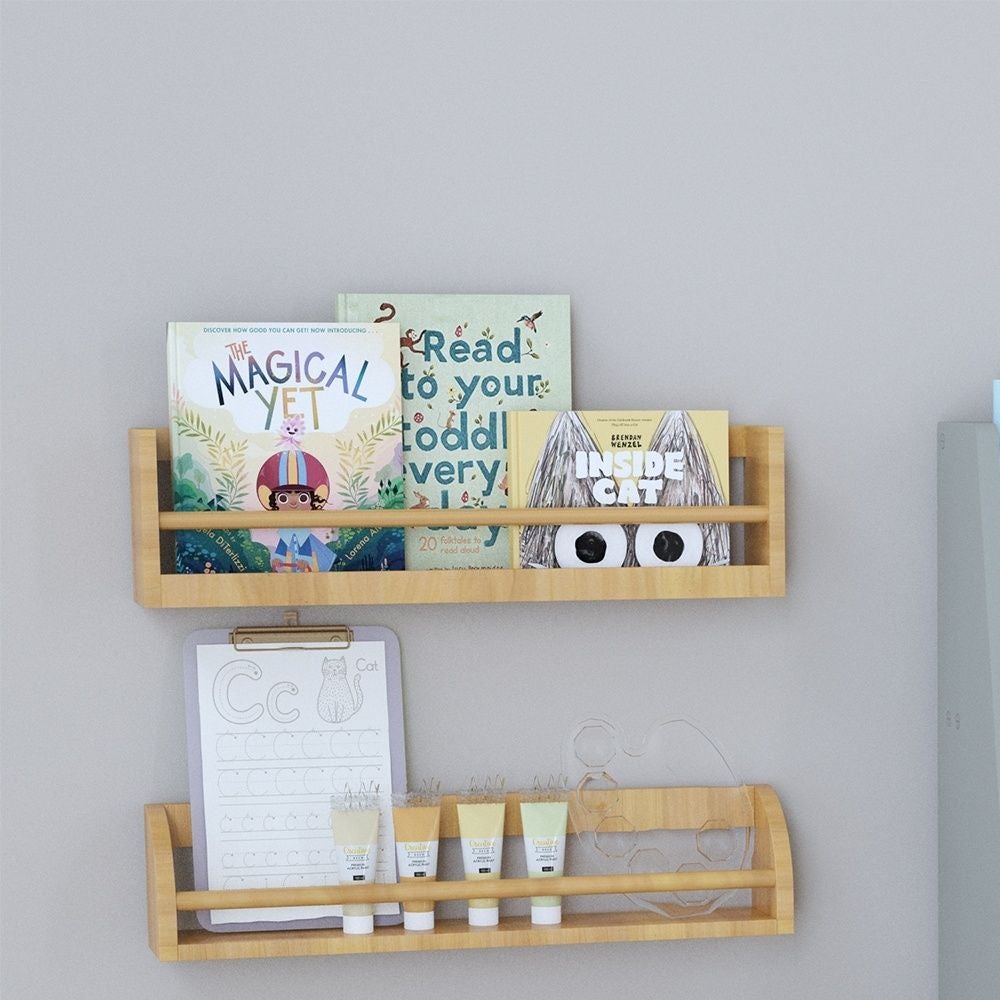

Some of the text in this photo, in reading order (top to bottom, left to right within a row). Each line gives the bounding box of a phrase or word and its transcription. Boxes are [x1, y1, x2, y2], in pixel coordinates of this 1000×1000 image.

[225, 340, 252, 361] THE
[423, 327, 521, 364] Read
[211, 350, 369, 406] MAGICAL
[401, 367, 542, 410] to your
[255, 386, 324, 431] YET
[403, 411, 508, 451] oddl
[403, 460, 501, 496] very
[575, 449, 685, 481] INSIDE
[592, 478, 663, 505] CAT
[345, 535, 370, 560] Lorena
[419, 536, 437, 551] 20
[355, 658, 379, 673] Cat
